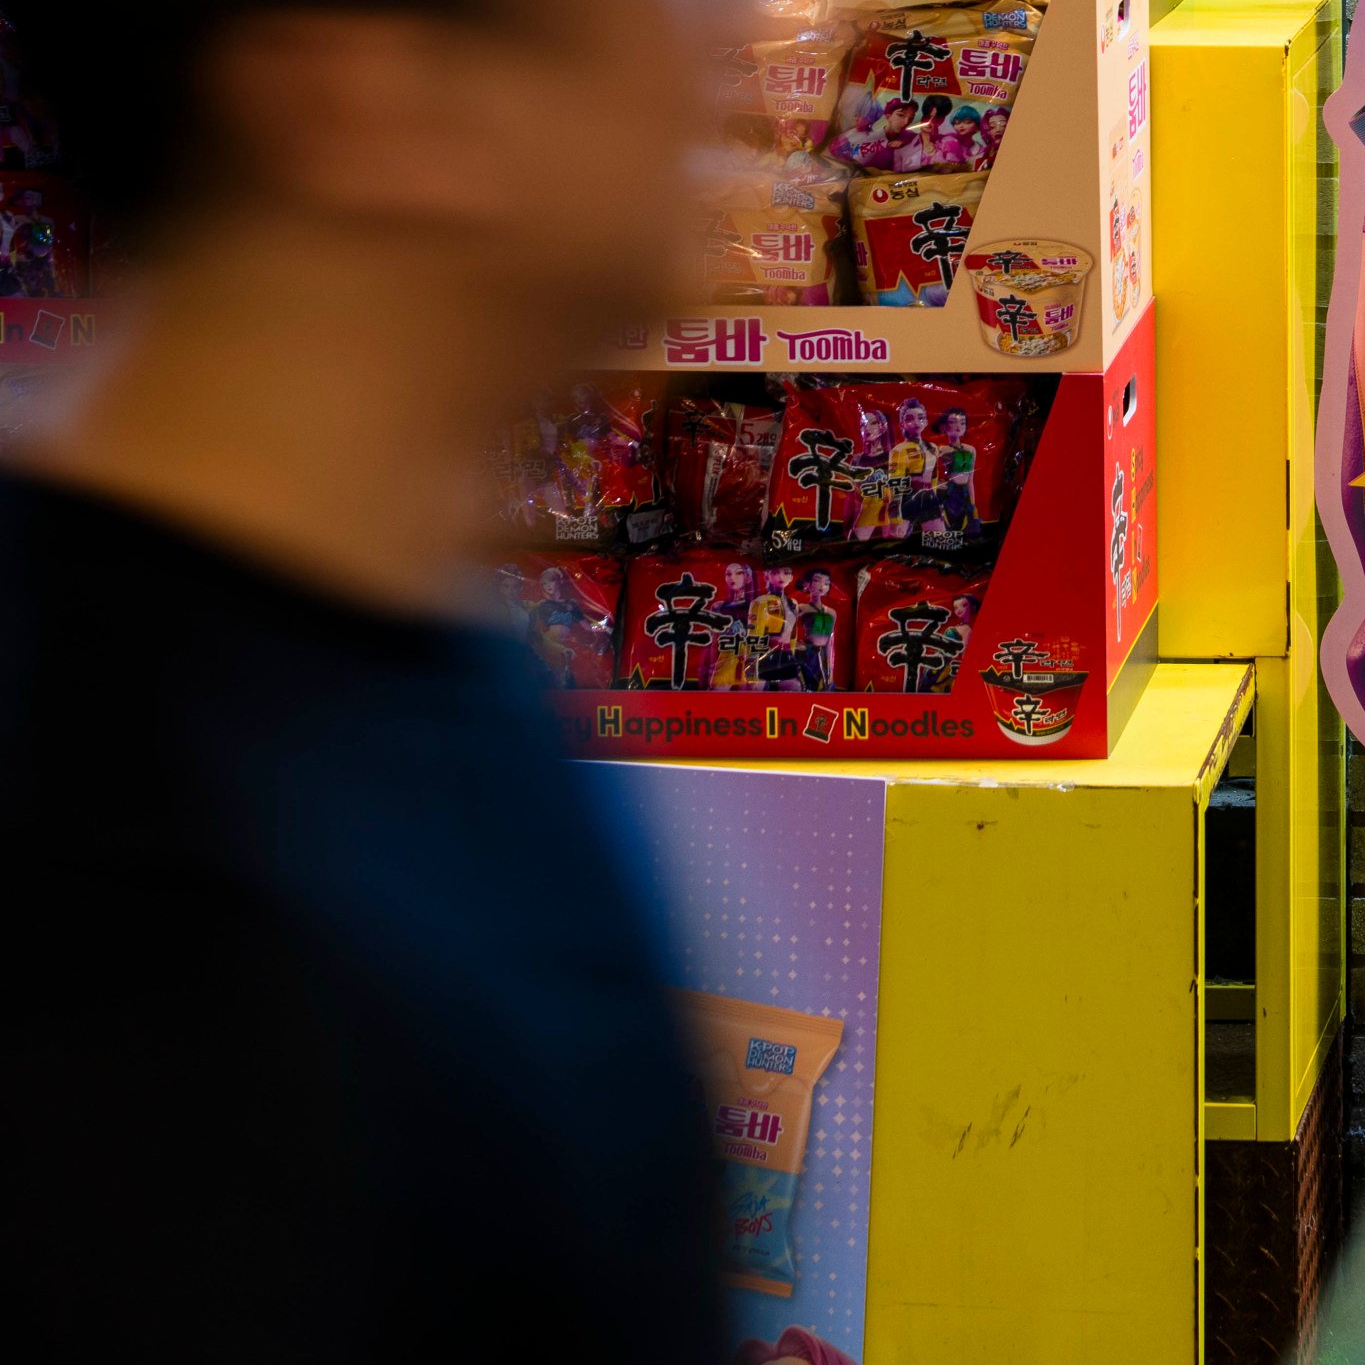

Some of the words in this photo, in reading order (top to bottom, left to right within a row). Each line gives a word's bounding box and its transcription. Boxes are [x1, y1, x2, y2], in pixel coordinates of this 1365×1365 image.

[983, 9, 1026, 22] DEMON
[958, 47, 1023, 84] 툼바
[765, 63, 828, 98] 툼바
[916, 75, 947, 88] 라면
[967, 81, 1007, 100] Toomba
[774, 98, 815, 113] Toomba
[890, 186, 920, 200] 농심
[751, 234, 815, 263] 툼바
[910, 201, 974, 292] 辛
[760, 266, 806, 281] Toomba
[986, 249, 1034, 274] 辛
[996, 294, 1039, 343] 辛
[662, 317, 770, 366] 툼바
[776, 328, 890, 363] Toomba
[788, 428, 874, 531] 辛
[860, 476, 912, 499] 라면
[921, 530, 964, 538] KPOP
[644, 571, 733, 690] 辛
[718, 633, 770, 657] 라면
[878, 599, 965, 693] 辛
[993, 638, 1051, 679] 辛
[597, 705, 766, 741] Happiness
[765, 706, 799, 739] In
[843, 707, 976, 742] Noodles
[1012, 693, 1052, 736] 辛
[748, 1049, 794, 1067] DEMON
[750, 1038, 796, 1055] KPOP
[714, 1103, 784, 1147] 툼바
